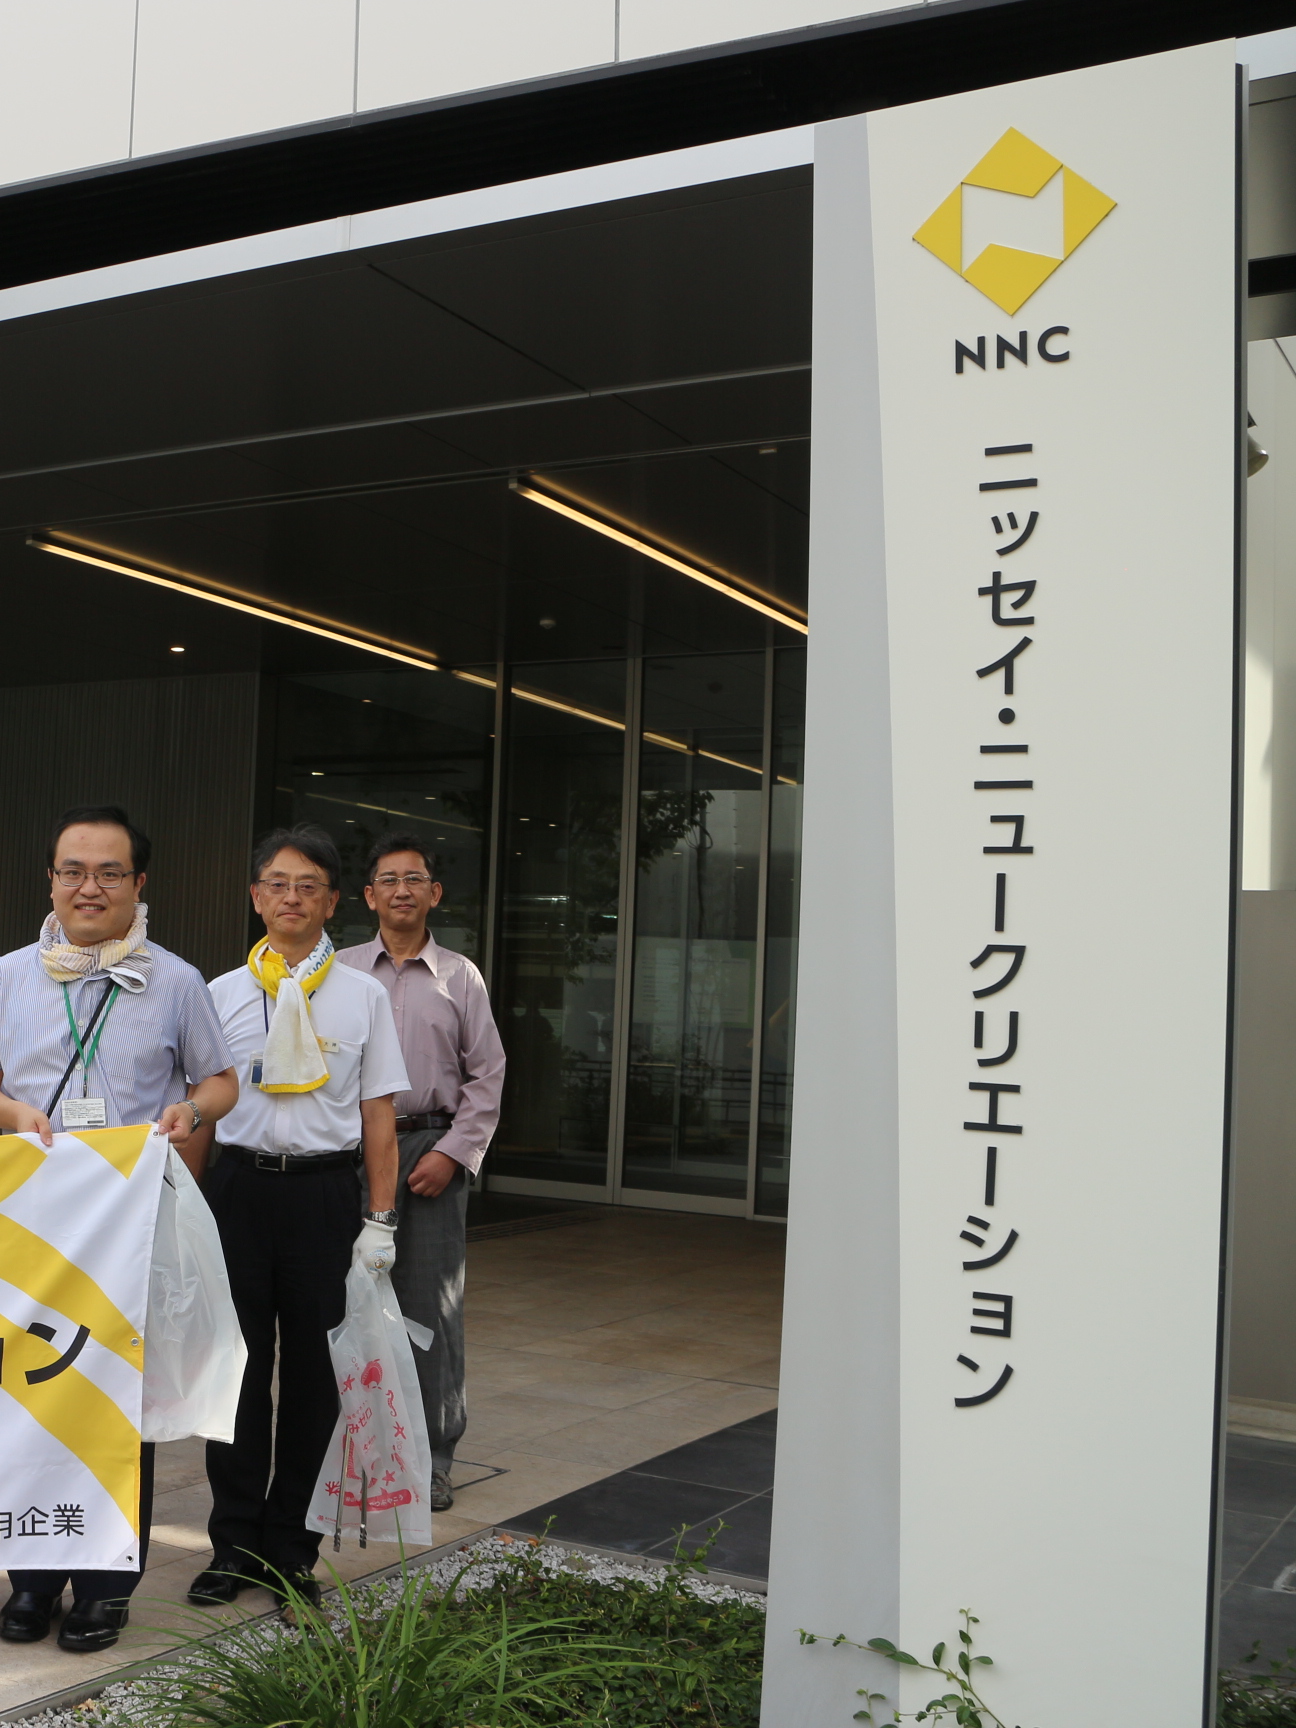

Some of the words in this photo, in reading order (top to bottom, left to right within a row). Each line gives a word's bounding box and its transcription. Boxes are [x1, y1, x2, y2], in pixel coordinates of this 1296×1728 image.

[955, 325, 1070, 374] NNC
[954, 443, 1039, 1408] ニッセイ・ニュークリエーション
